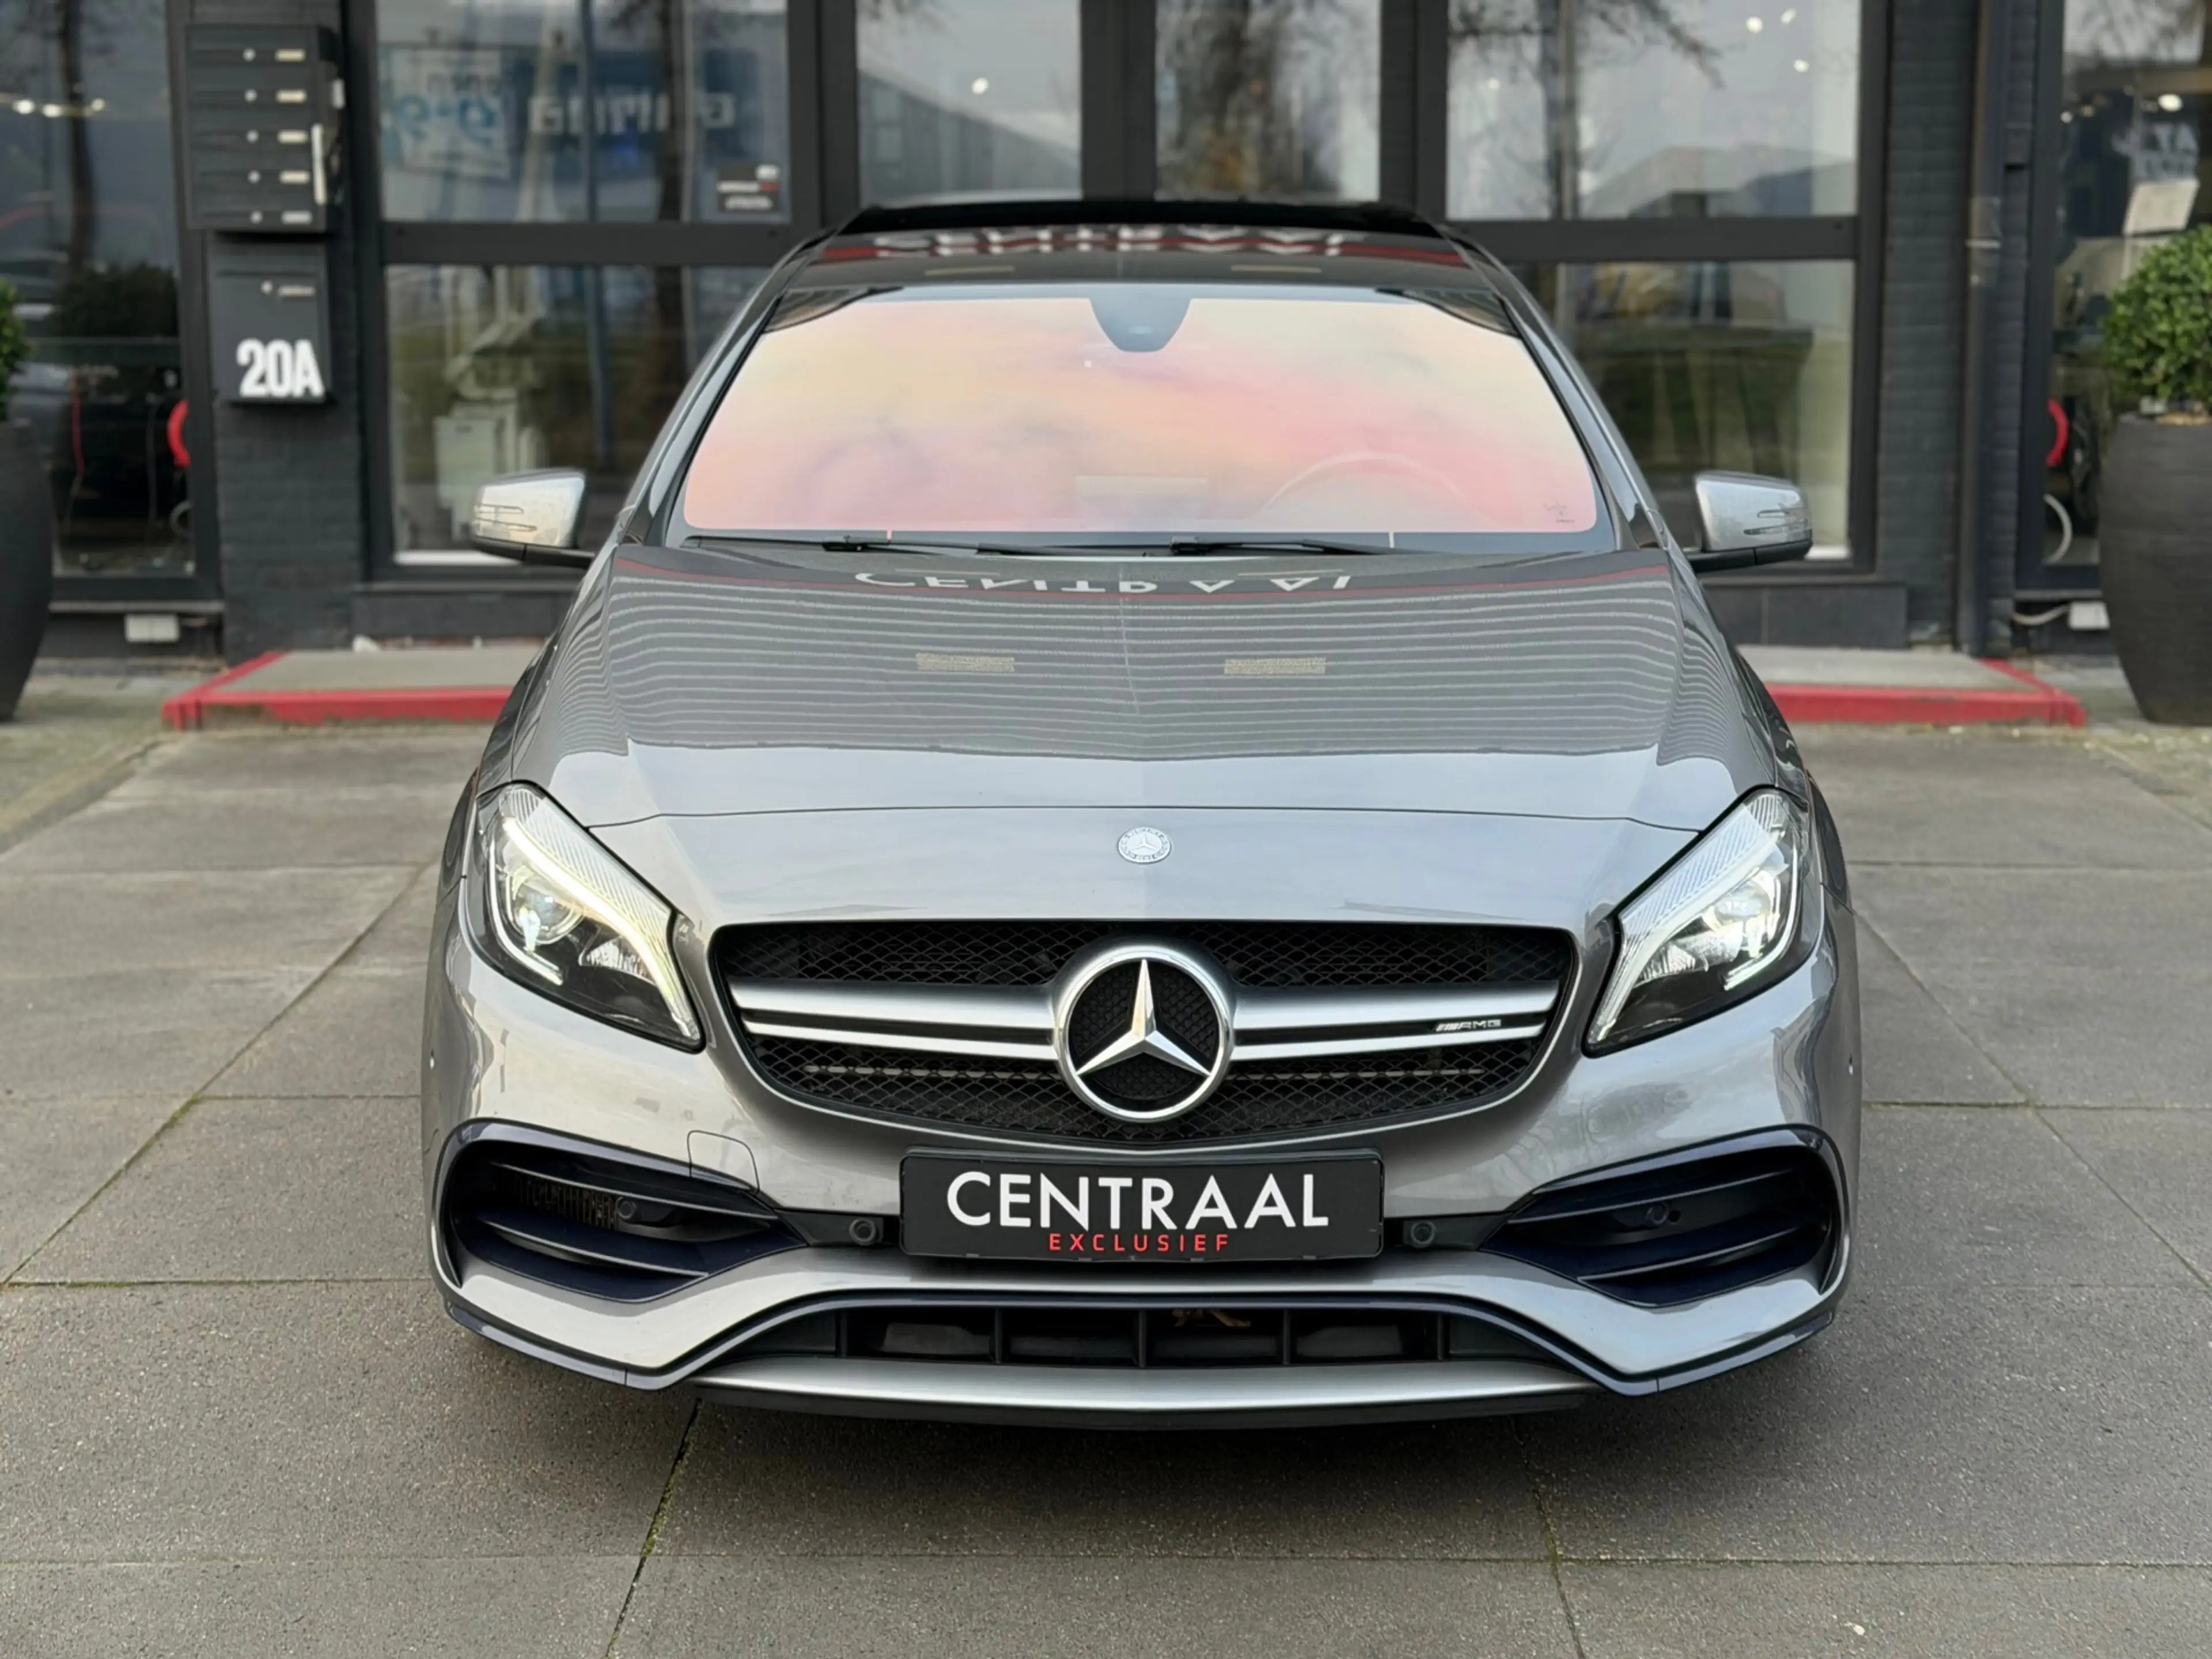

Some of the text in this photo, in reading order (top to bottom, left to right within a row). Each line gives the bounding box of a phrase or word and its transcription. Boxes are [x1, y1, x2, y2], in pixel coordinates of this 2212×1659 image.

[236, 338, 324, 397] 20A
[1457, 1018, 1502, 1031] AMG
[946, 1171, 1329, 1231] CENTRAAL
[1050, 1233, 1229, 1252] EXCLUSIEF
